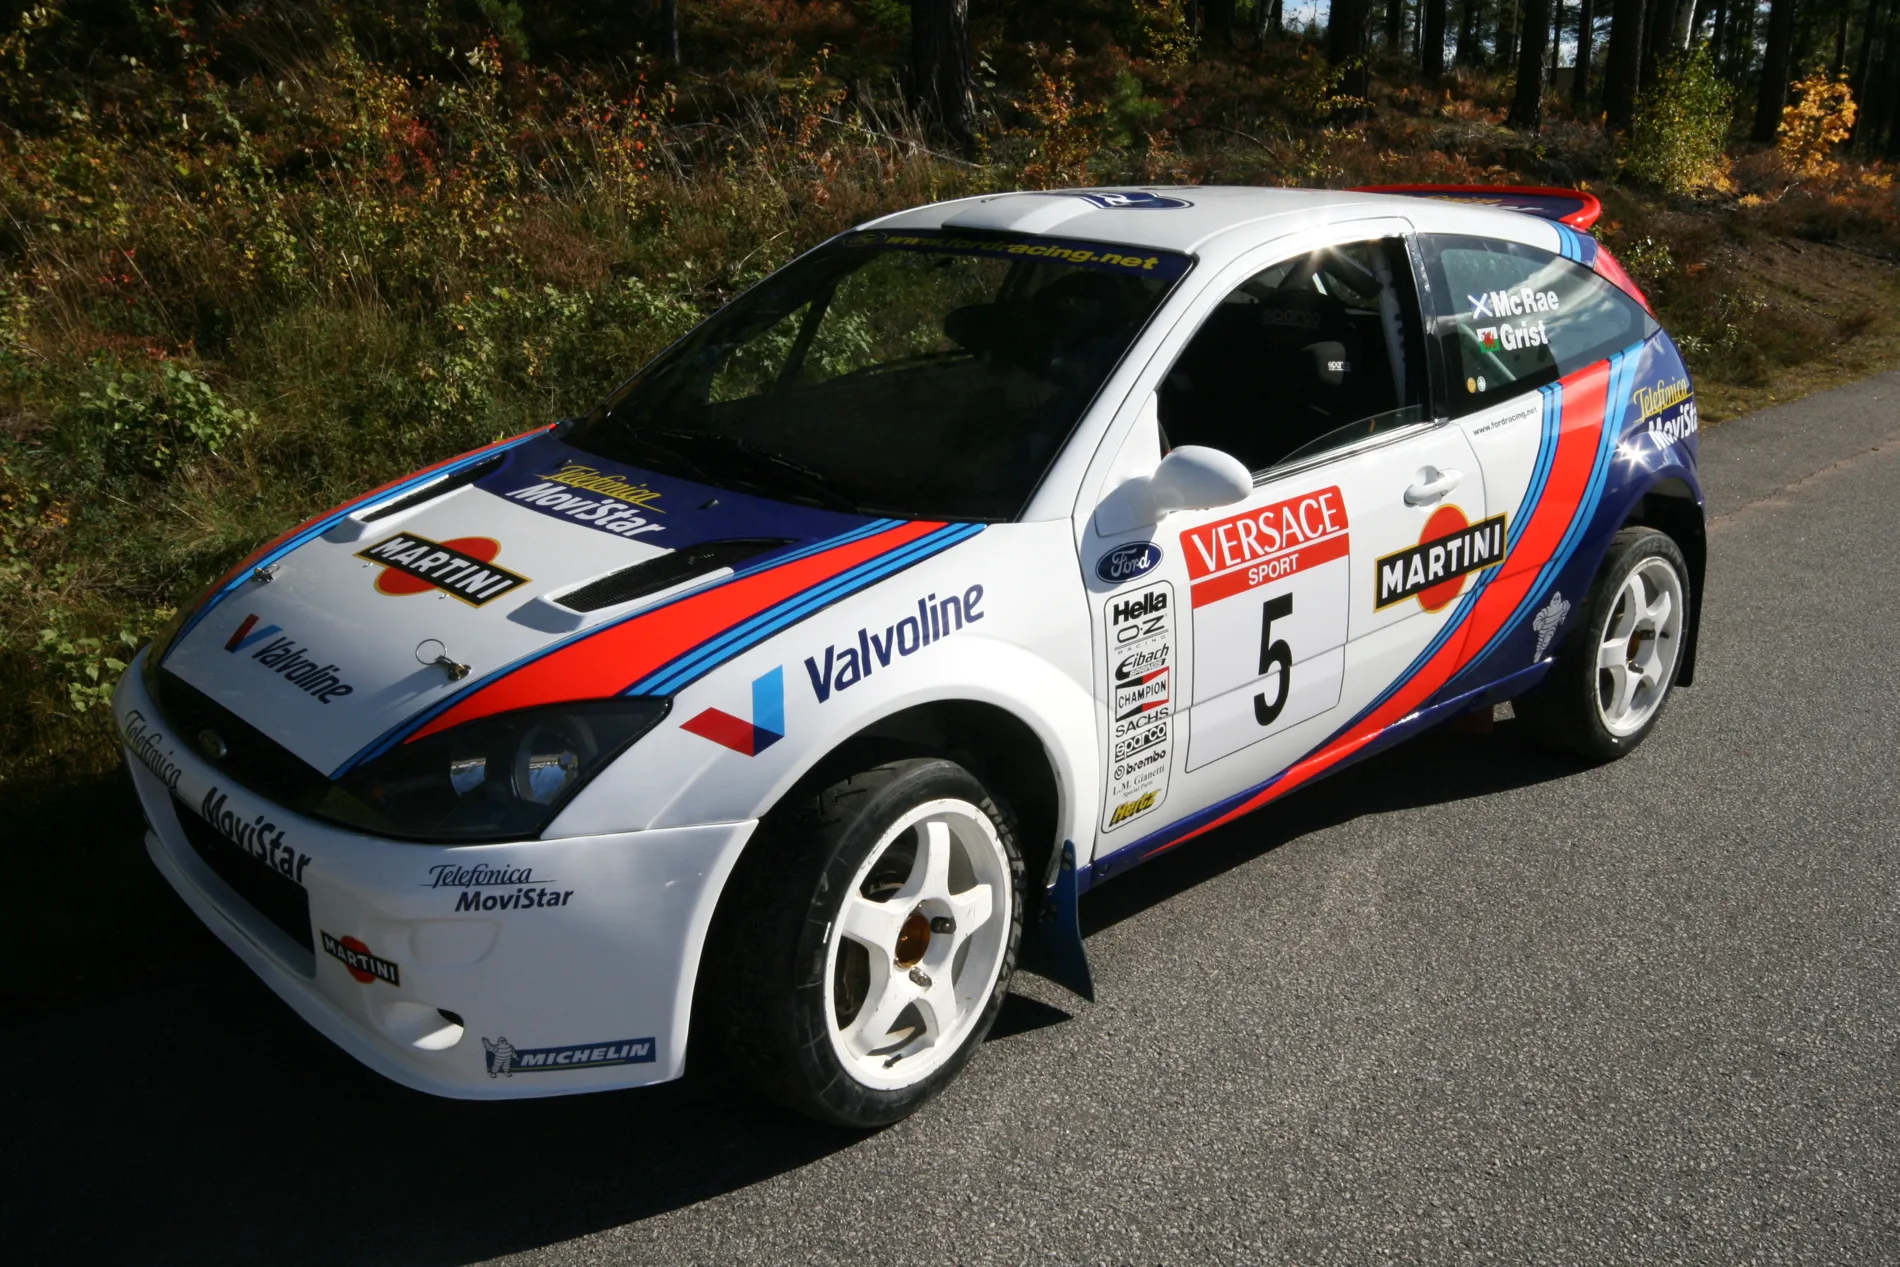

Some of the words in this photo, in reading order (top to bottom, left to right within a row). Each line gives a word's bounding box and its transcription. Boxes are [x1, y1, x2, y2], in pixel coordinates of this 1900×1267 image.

[1490, 287, 1559, 318] McRae
[1500, 320, 1549, 351] Grist
[1472, 406, 1538, 436] www.fordracing.net
[505, 482, 667, 537] MoviStar
[1191, 492, 1341, 573] VERSACE
[369, 536, 514, 600] MARTINI
[1111, 548, 1151, 577] Ford
[1248, 554, 1299, 587] SPORT
[1381, 523, 1501, 600] MARTINI
[1113, 591, 1167, 626] Hella
[804, 584, 985, 704] Valvoline
[1115, 642, 1170, 681] Eibach
[1253, 591, 1294, 727] 5
[252, 636, 354, 704] Valvoline
[1118, 680, 1167, 709] CHAMPION
[1115, 707, 1169, 738] SACHS
[1116, 723, 1167, 759] sparco
[1126, 749, 1167, 776] brembo
[1109, 789, 1160, 828] Hertz
[202, 786, 312, 884] MoviStar
[455, 887, 575, 912] MoviStar
[323, 934, 396, 982] MARTINI
[519, 1042, 651, 1067] MICHELIN
